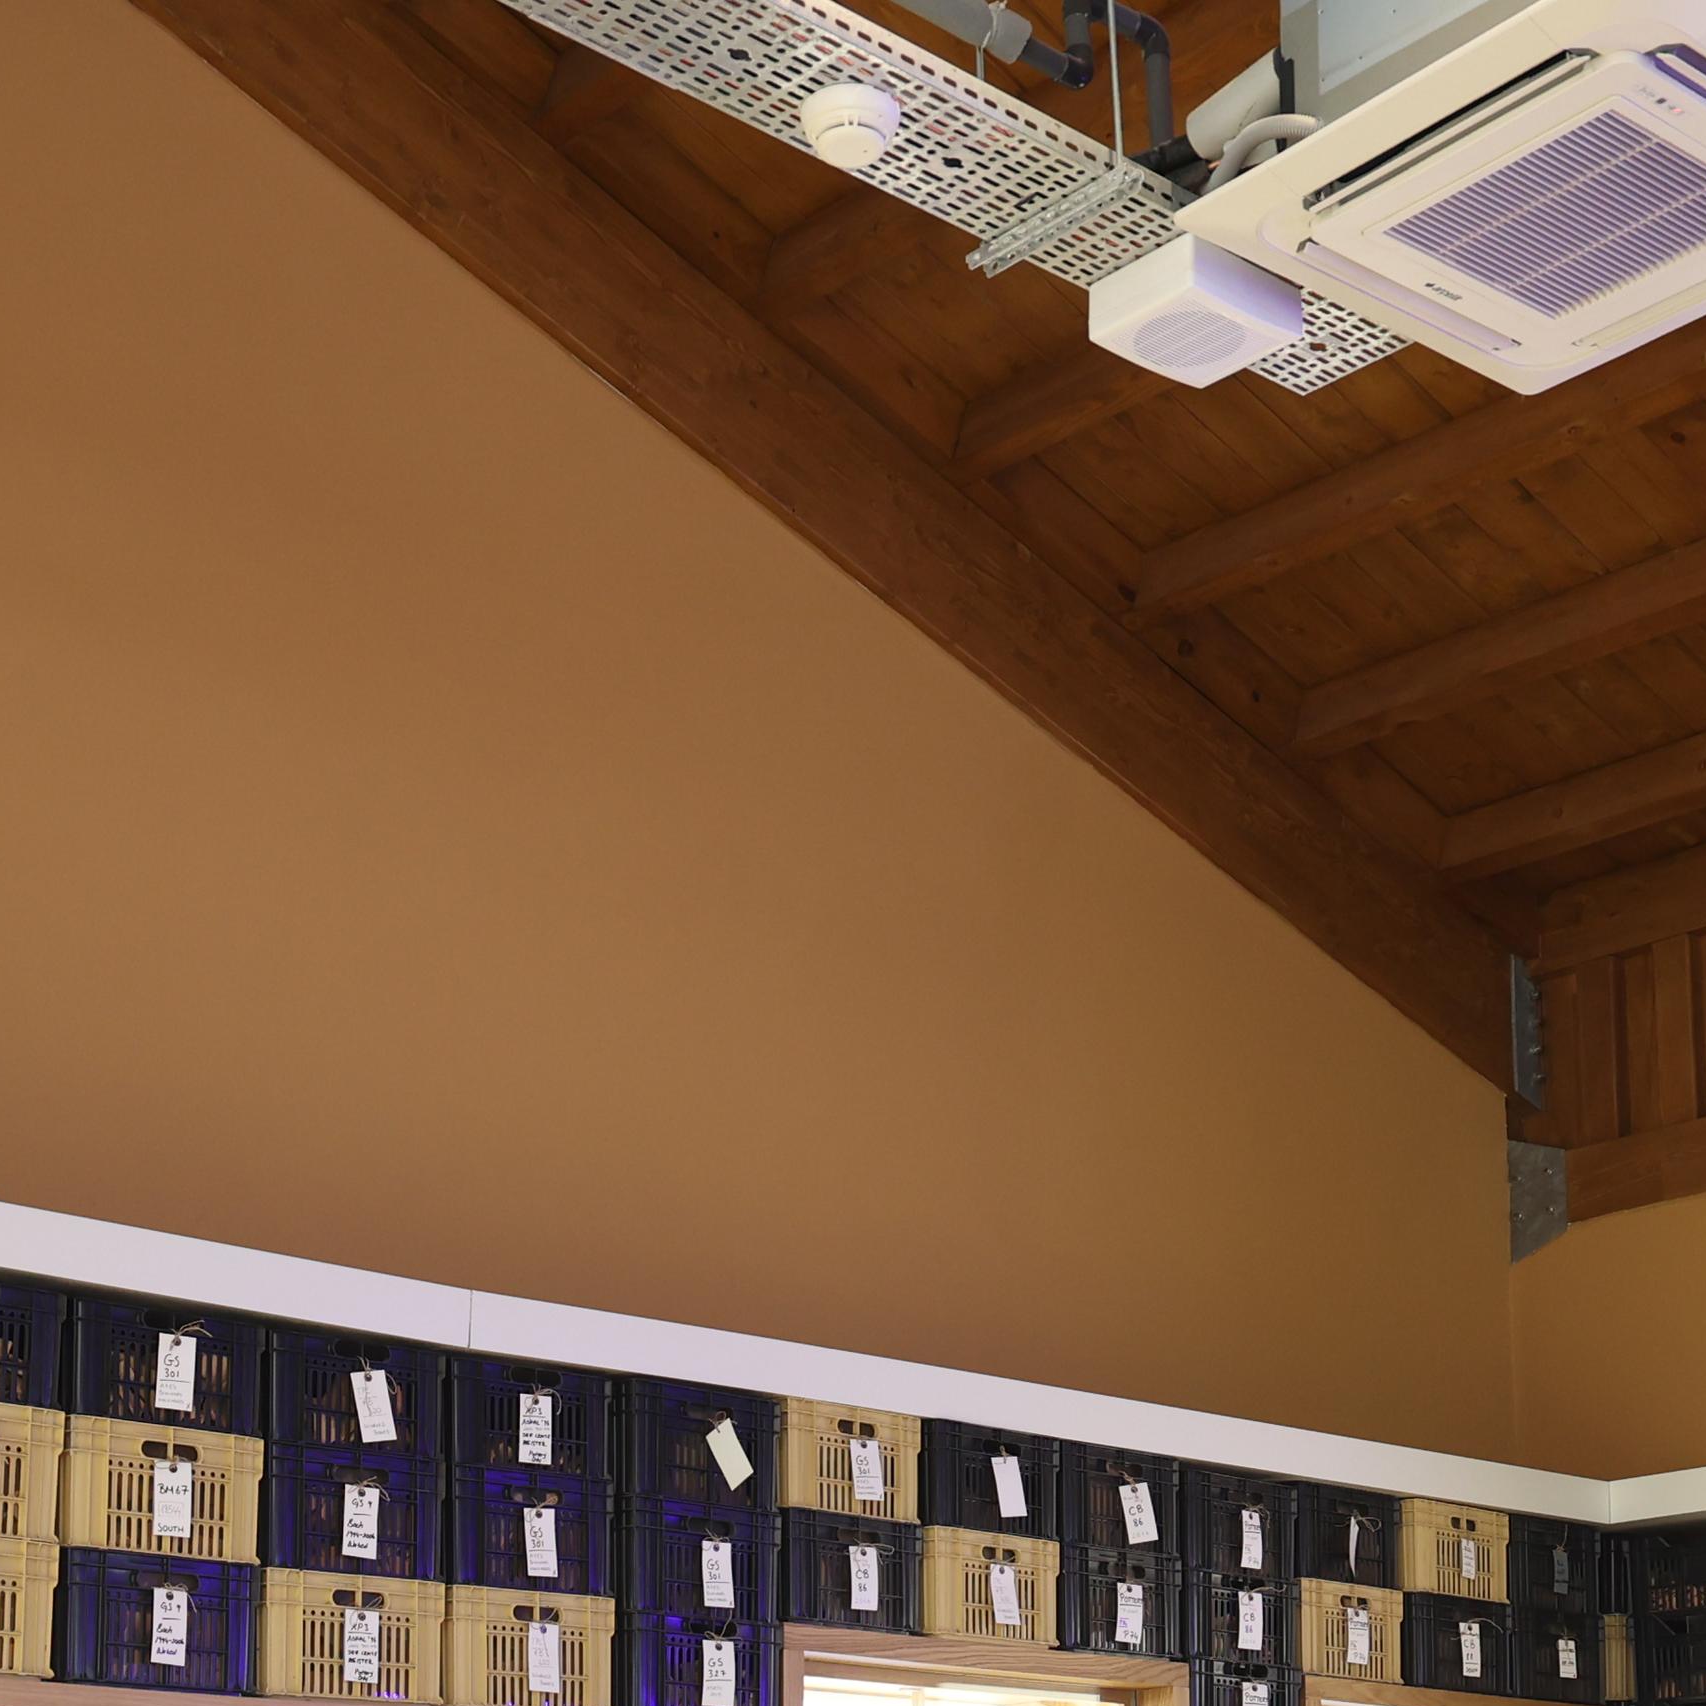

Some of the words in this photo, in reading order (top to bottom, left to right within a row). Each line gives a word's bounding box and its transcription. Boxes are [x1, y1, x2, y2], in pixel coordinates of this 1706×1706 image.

[163, 1354, 180, 1367] GS
[855, 1455, 869, 1466] GS
[1128, 1505, 1143, 1515] CB
[157, 1524, 184, 1533] SOUTH
[530, 1527, 543, 1538] GS
[707, 1559, 720, 1570] GS
[708, 1657, 724, 1667] GS
